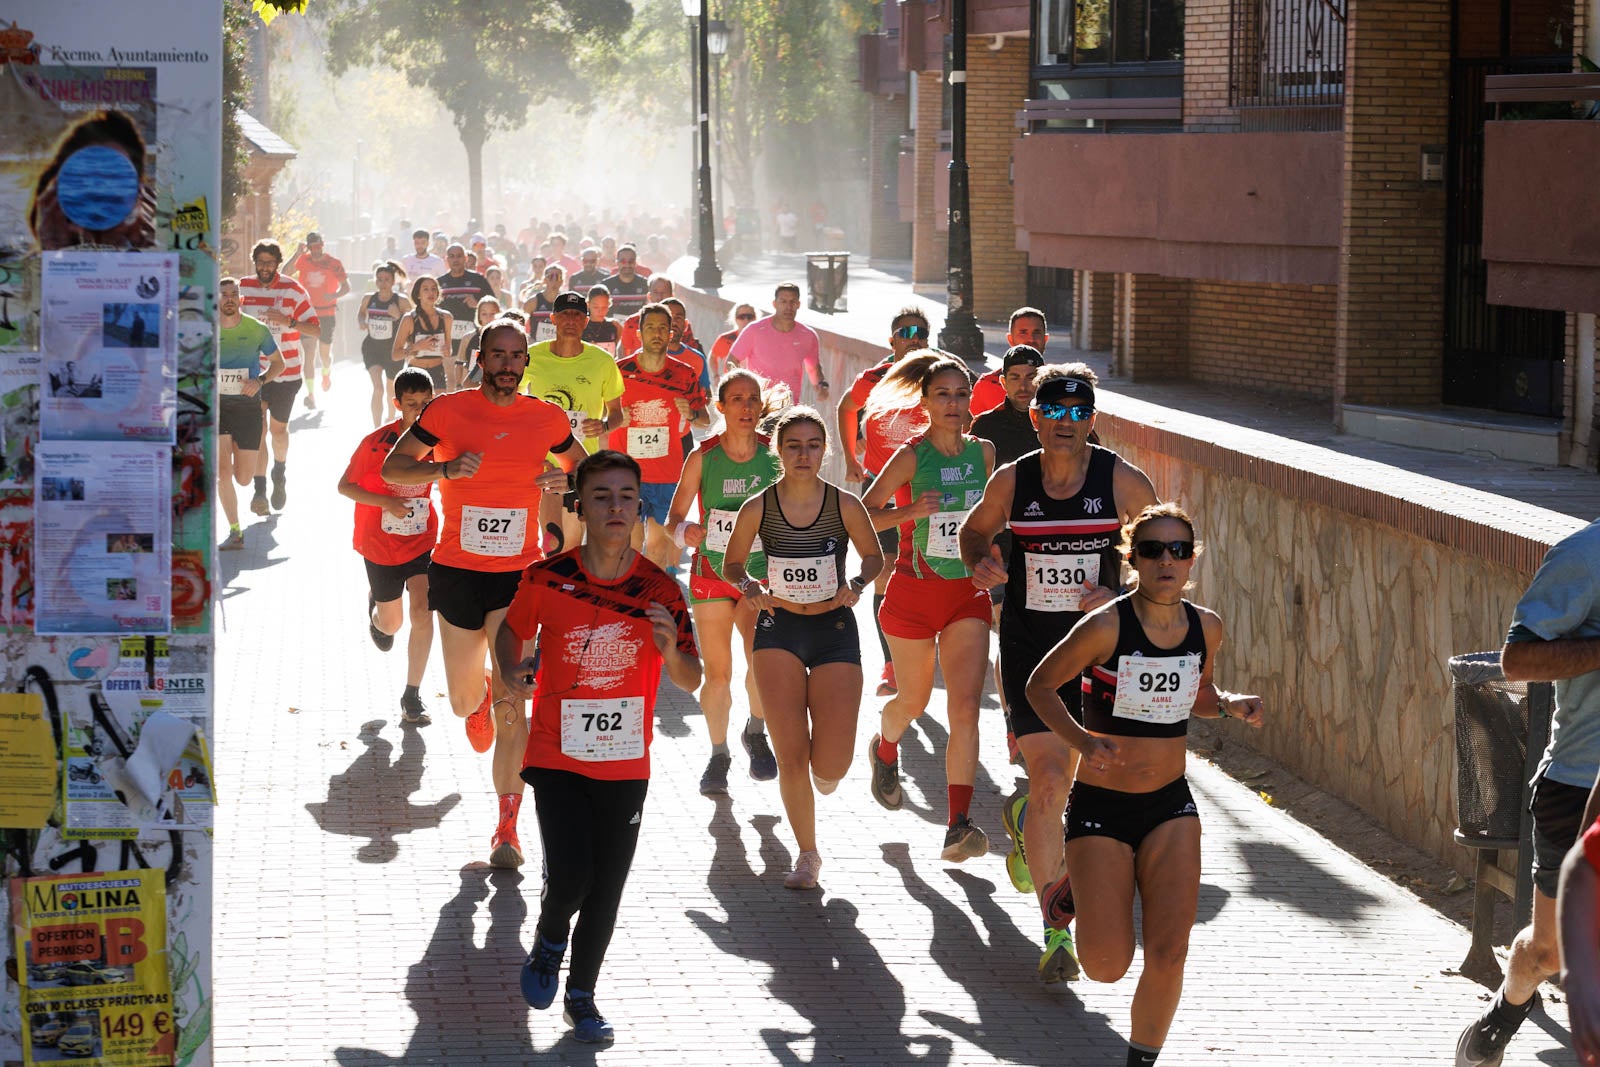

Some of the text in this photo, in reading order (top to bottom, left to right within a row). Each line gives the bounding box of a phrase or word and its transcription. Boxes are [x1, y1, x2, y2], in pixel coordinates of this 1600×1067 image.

[107, 47, 208, 64] Ayuntamiento
[637, 434, 659, 445] 124
[723, 478, 746, 494] ATARFE
[477, 517, 511, 533] 627
[939, 522, 961, 537] 12
[783, 568, 818, 582] 698
[1035, 567, 1086, 585] 1330
[106, 679, 142, 690] OFERTA
[1139, 672, 1180, 692] 929
[581, 712, 622, 732] 762
[66, 829, 126, 839] Mejoramos
[59, 880, 140, 891] AUTOESCUELAS
[33, 911, 67, 919] TODOS
[91, 906, 141, 915] PERMISOS
[105, 917, 148, 966] B
[38, 943, 94, 958] PERMISO
[26, 993, 168, 1013] CON 10 CLASES PRÁCTICAS
[103, 1011, 170, 1038] 149 €
